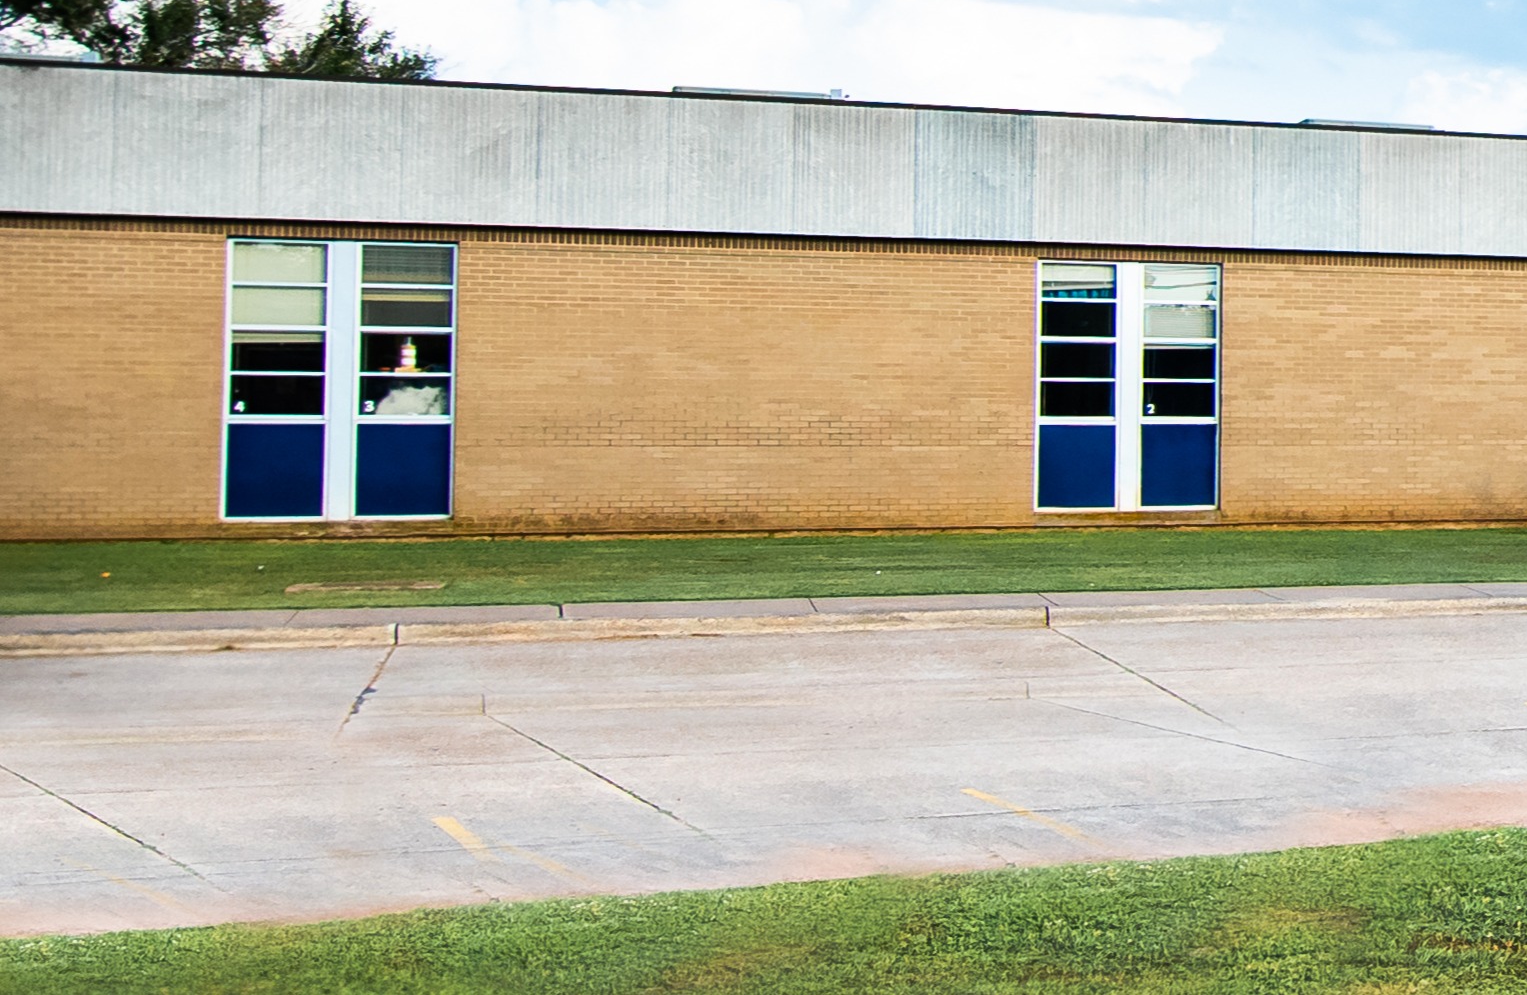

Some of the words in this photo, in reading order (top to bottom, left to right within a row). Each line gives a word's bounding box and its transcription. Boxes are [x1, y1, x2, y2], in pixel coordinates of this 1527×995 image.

[233, 401, 245, 413] 4
[364, 401, 375, 413] 3
[1147, 403, 1156, 414] 2
